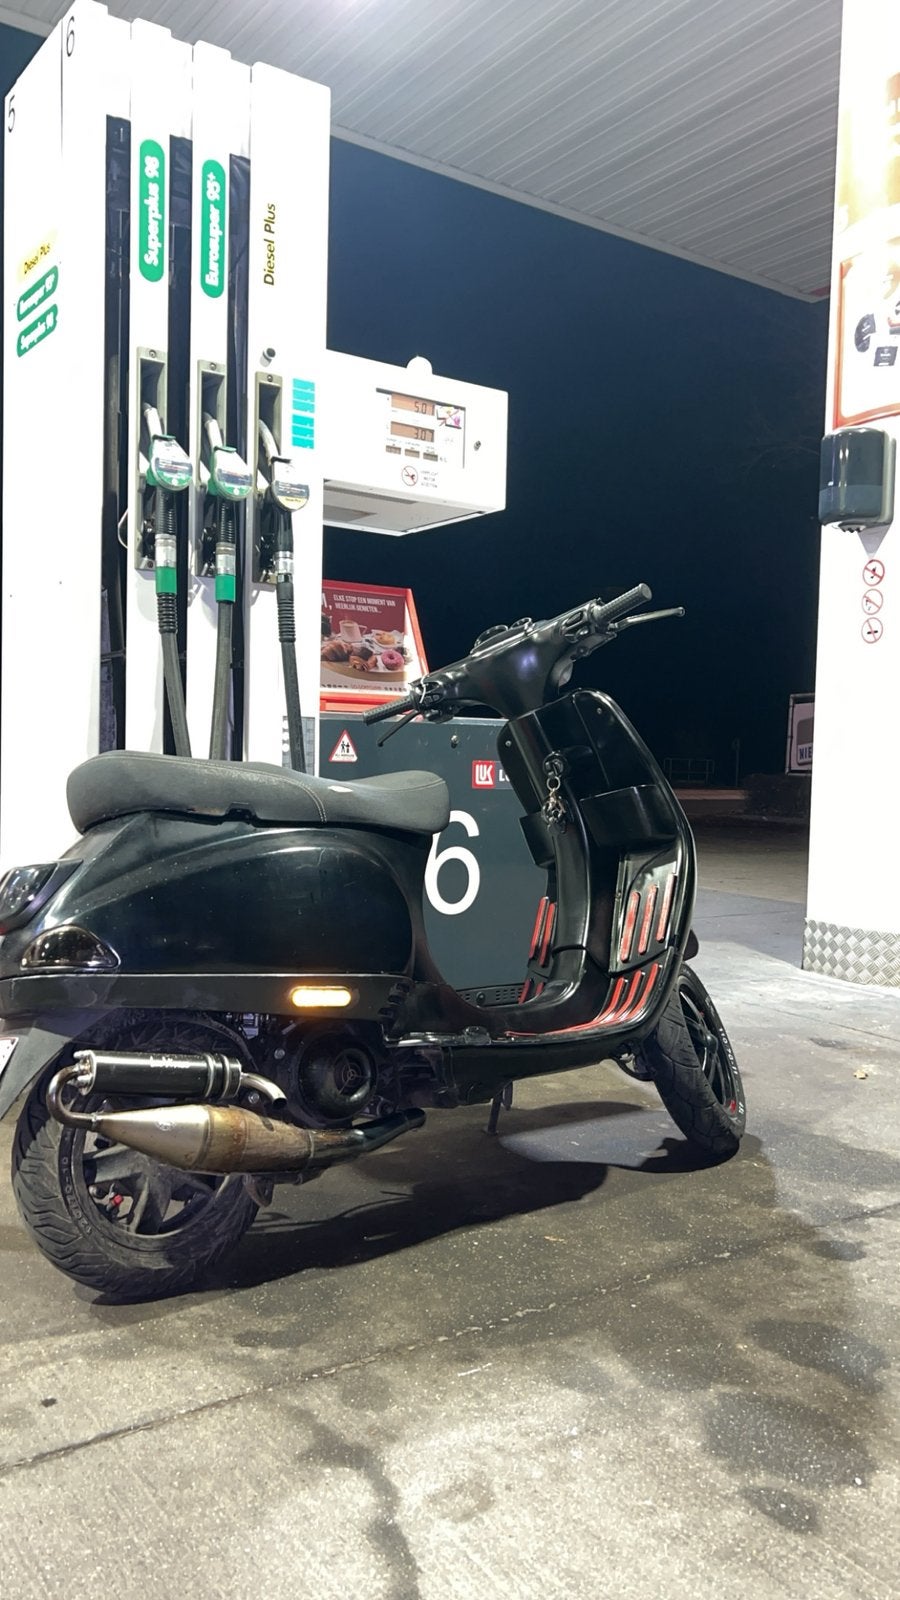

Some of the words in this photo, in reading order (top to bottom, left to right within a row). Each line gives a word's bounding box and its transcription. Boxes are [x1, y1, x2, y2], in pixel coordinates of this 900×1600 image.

[66, 15, 76, 58] 6
[7, 94, 16, 134] 5
[143, 182, 163, 268] Superplus
[263, 203, 276, 235] Plus
[204, 203, 223, 287] Eurosuper
[263, 238, 275, 286] Diesel
[333, 594, 345, 602] ELKE
[345, 595, 357, 603] STOP
[357, 596, 367, 604] EEN
[366, 597, 386, 605] MOMENT
[385, 599, 396, 607] VAN
[424, 810, 480, 915] 6
